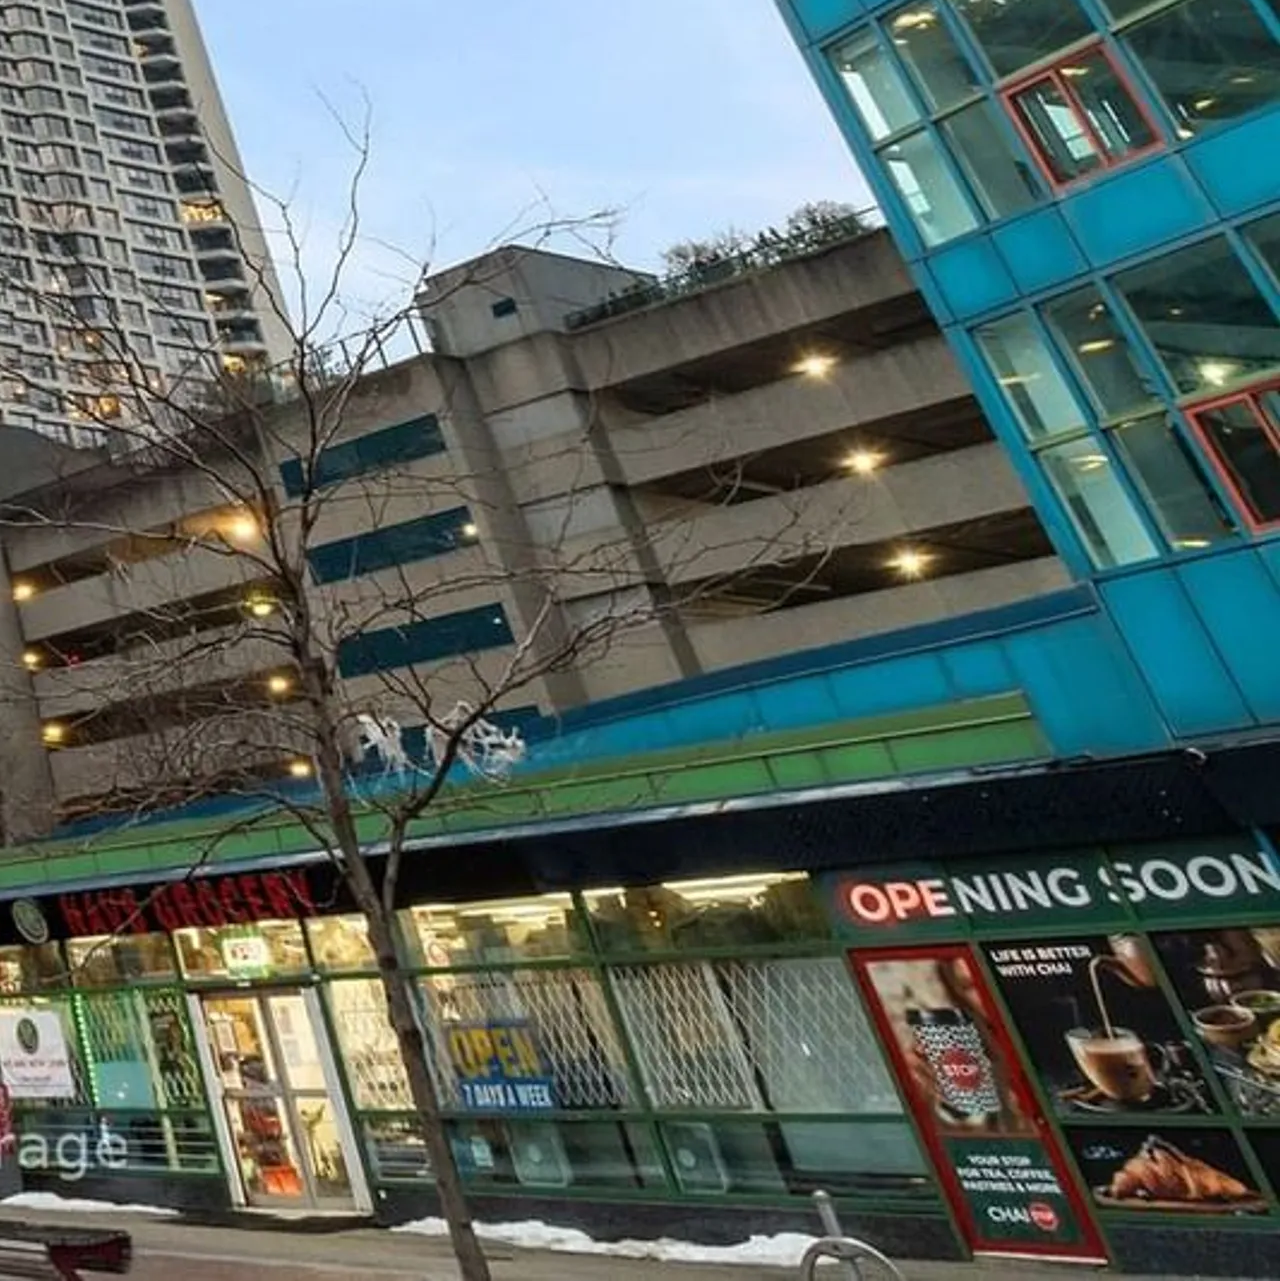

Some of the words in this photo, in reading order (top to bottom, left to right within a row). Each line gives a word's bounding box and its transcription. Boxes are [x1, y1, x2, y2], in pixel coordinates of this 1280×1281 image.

[850, 867, 1090, 921] OPENING
[1097, 851, 1280, 904] SOON
[989, 948, 1021, 963] LIFE
[1021, 948, 1036, 961] IS
[1036, 944, 1092, 960] BETTER
[995, 964, 1037, 978] WITH
[1037, 961, 1073, 976] CHAI
[451, 1029, 542, 1078] OPEN
[462, 1084, 473, 1107] 7
[473, 1084, 506, 1108] DAYS
[505, 1084, 518, 1107] A
[514, 1084, 553, 1108] WEEK
[987, 1206, 1030, 1223] CHAI
